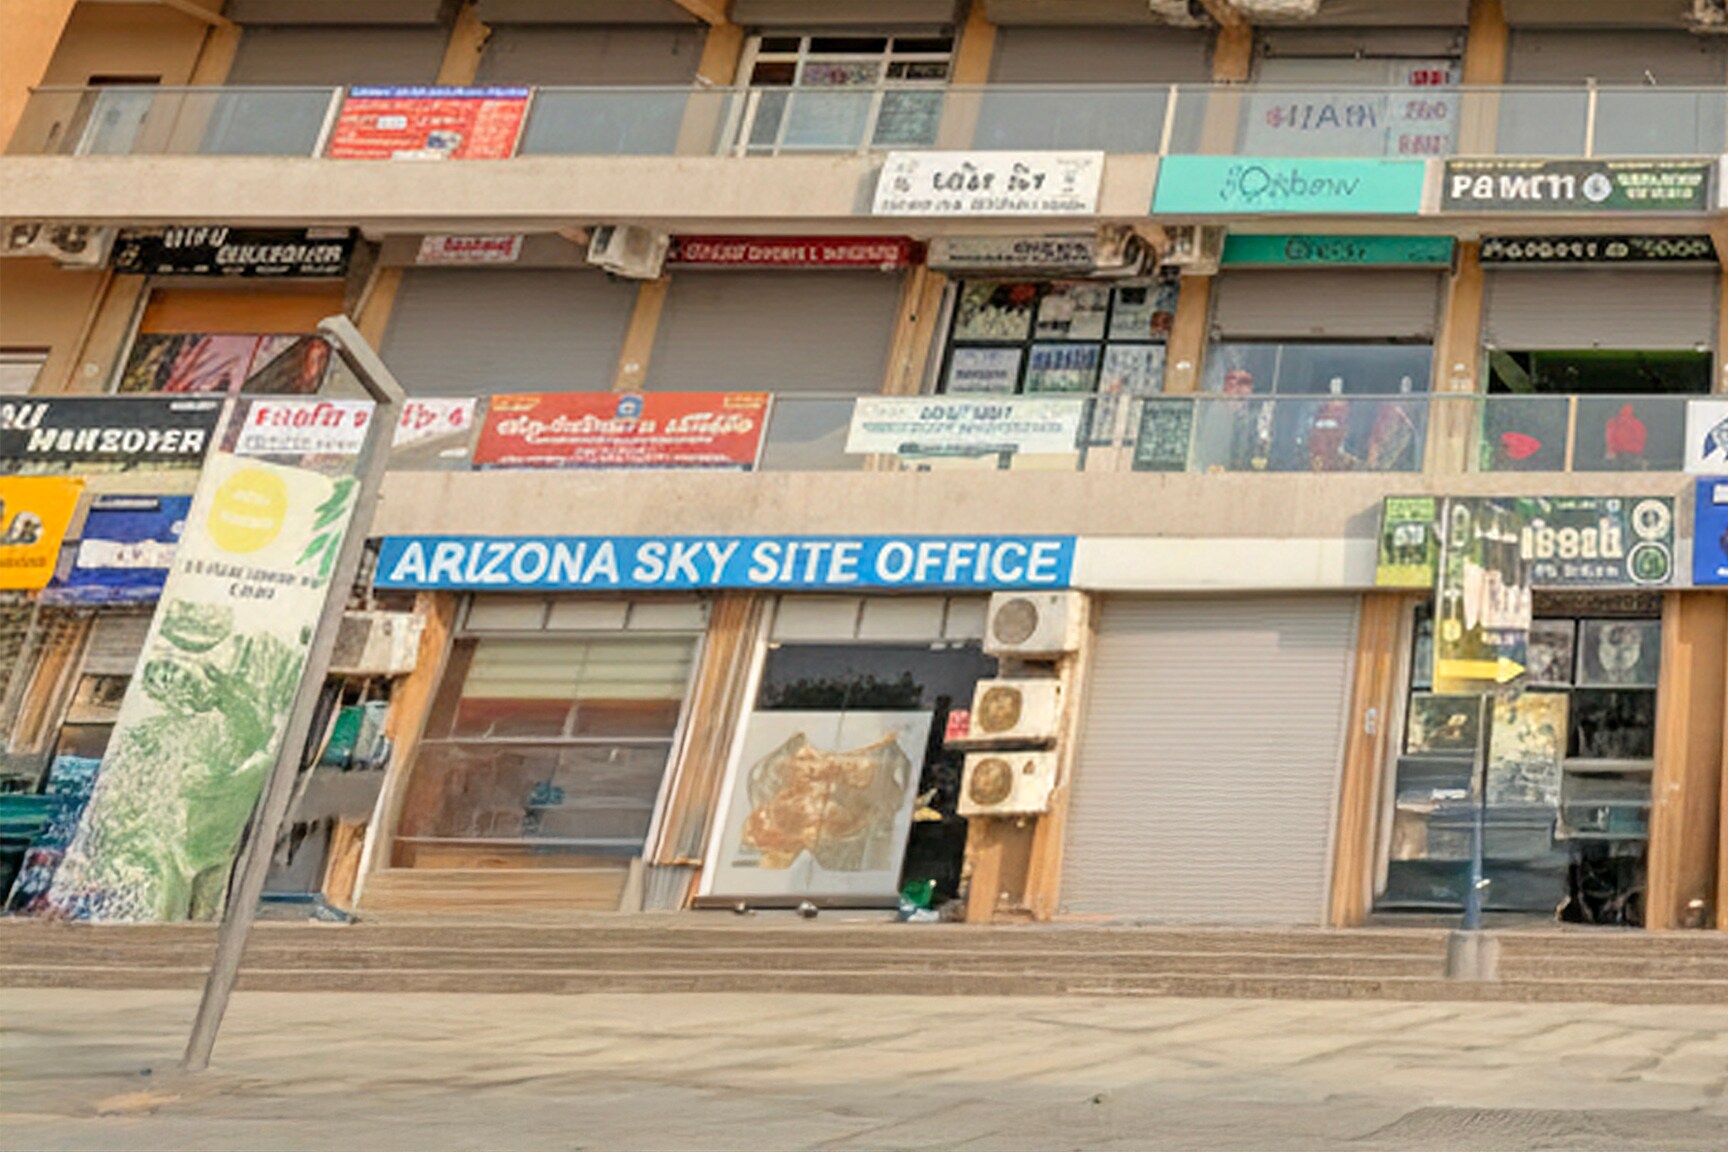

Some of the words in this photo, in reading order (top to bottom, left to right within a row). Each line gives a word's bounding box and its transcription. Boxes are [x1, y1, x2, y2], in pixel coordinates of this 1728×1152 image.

[390, 541, 620, 583] ARIZONA
[633, 541, 738, 583] SKY
[748, 541, 860, 583] SITE
[874, 541, 1061, 583] OFFICE
